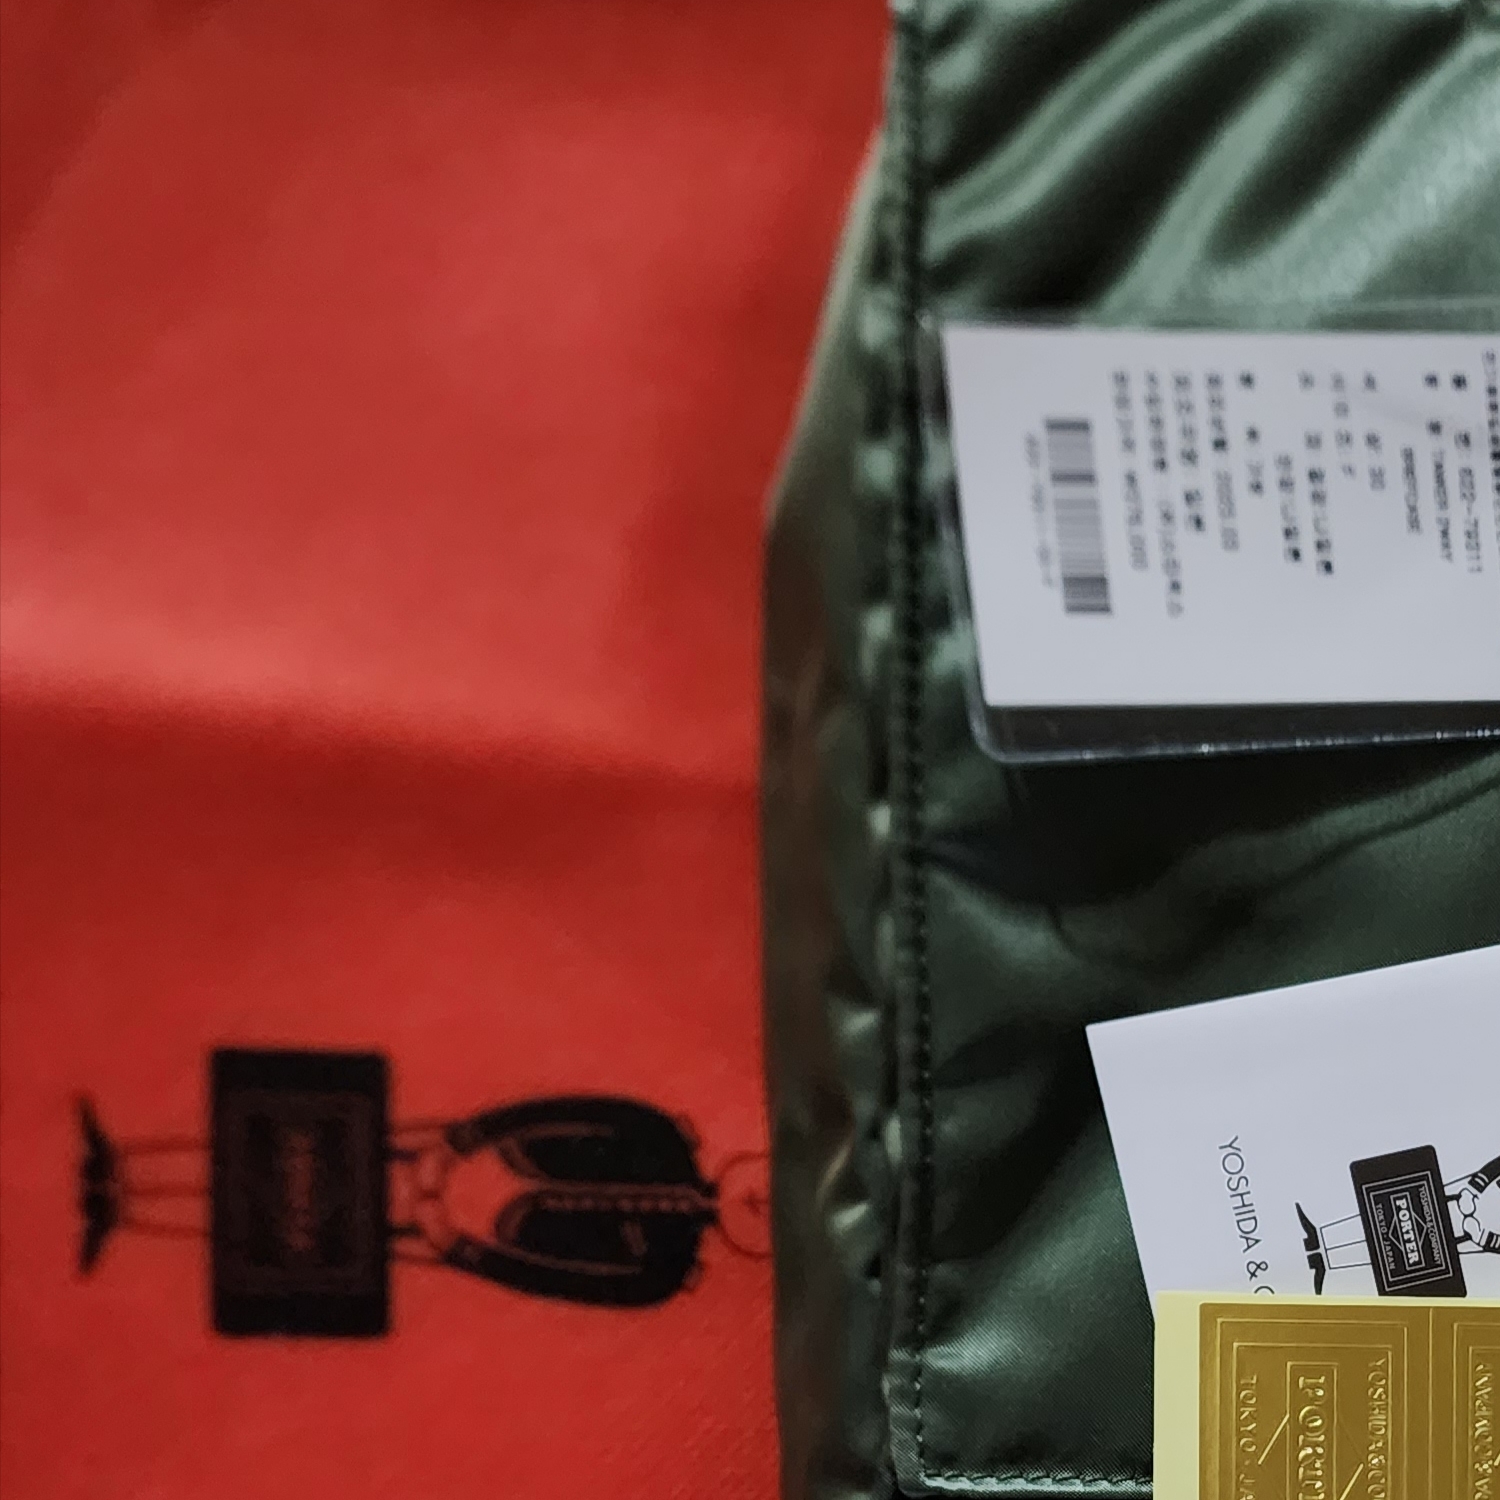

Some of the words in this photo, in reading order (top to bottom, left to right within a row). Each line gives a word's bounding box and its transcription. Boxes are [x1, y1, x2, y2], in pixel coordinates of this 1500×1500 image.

[1218, 1136, 1262, 1253] YOSHIDA
[1246, 1260, 1268, 1281] &
[1376, 1203, 1388, 1233] TOKYO
[1384, 1241, 1395, 1269] JAPAN
[1396, 1198, 1418, 1264] PORTER
[1240, 1375, 1256, 1452] TOKYO
